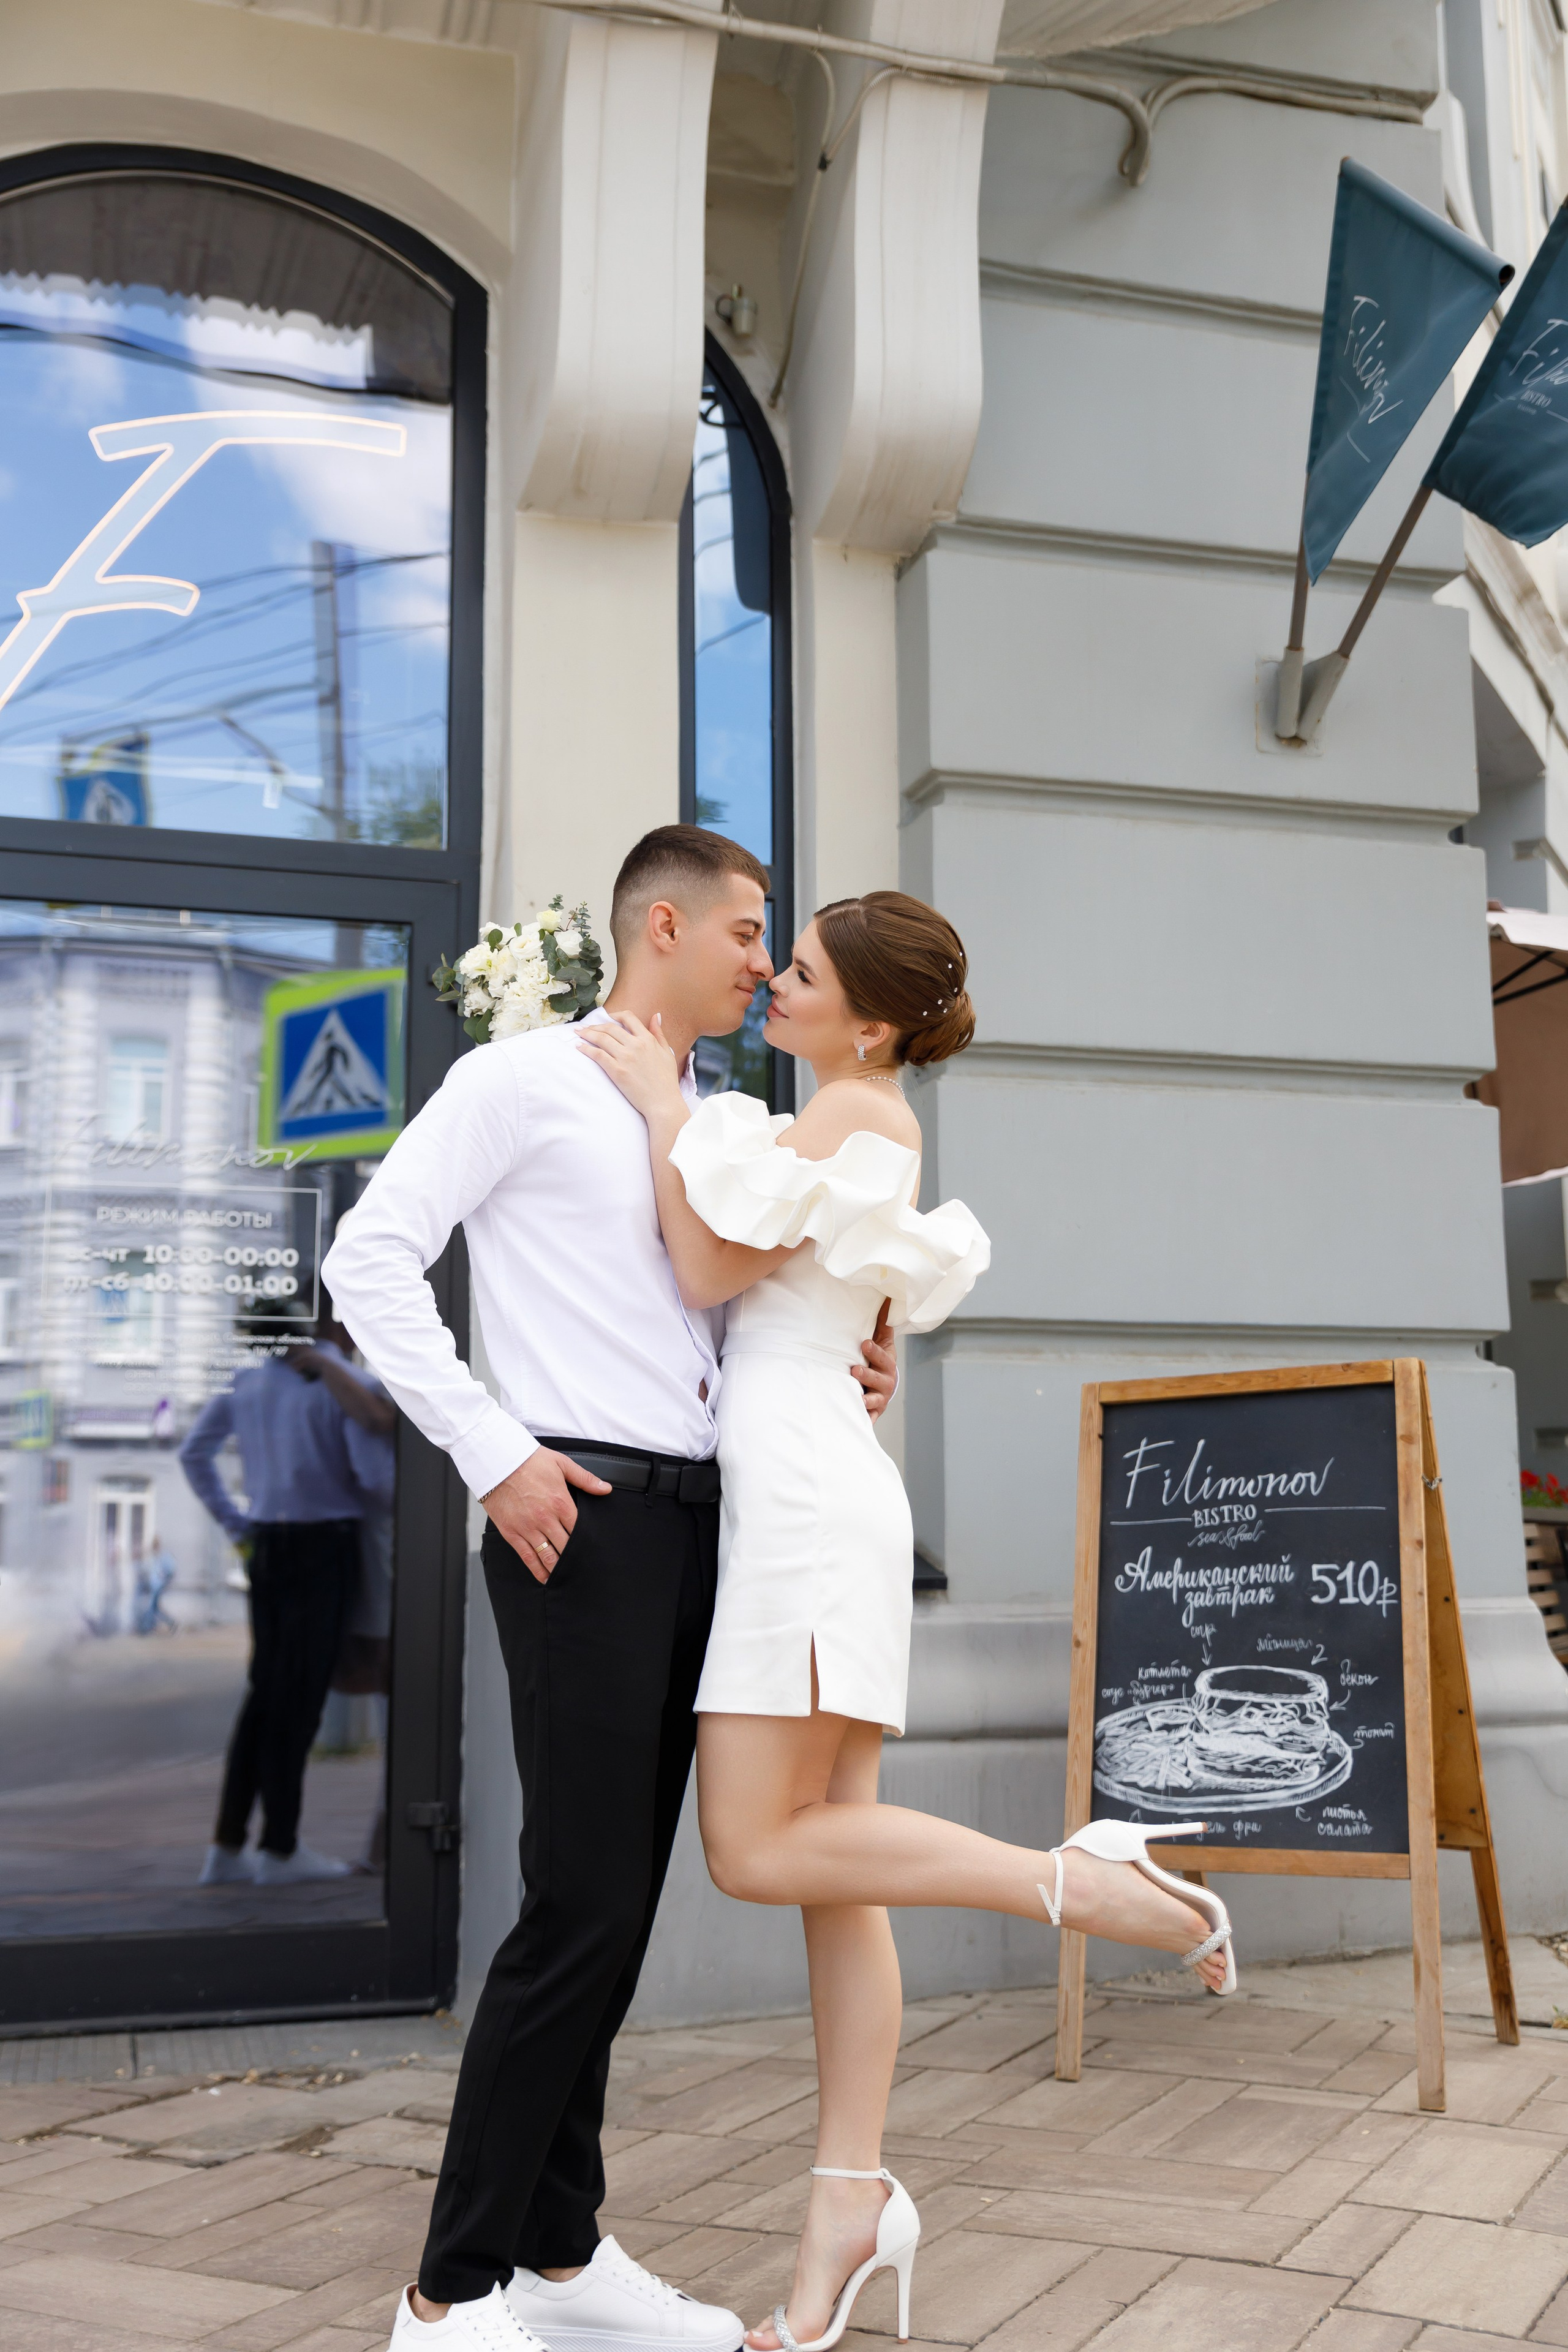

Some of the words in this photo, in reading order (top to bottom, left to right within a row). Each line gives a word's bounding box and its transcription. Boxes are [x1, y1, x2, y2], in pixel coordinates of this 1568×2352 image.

[96, 1205, 181, 1226] РЕЖИМ
[183, 1208, 273, 1229] РАБОТЫ
[143, 1243, 300, 1268] 10:00-00:00
[142, 1270, 299, 1296] 10:00-01:00
[1122, 1437, 1335, 1509] Filimonov
[1193, 1504, 1257, 1529] BISTRO
[1114, 1545, 1295, 1605] Американский
[1182, 1583, 1275, 1629] завтрак
[1138, 1659, 1193, 1681] котлета
[1340, 1658, 1379, 1687] бекон
[1101, 1687, 1125, 1706] соус
[1352, 1721, 1396, 1740] томат
[1322, 1803, 1368, 1822] листья
[1232, 1819, 1263, 1841] фри
[1317, 1820, 1374, 1837] салата
